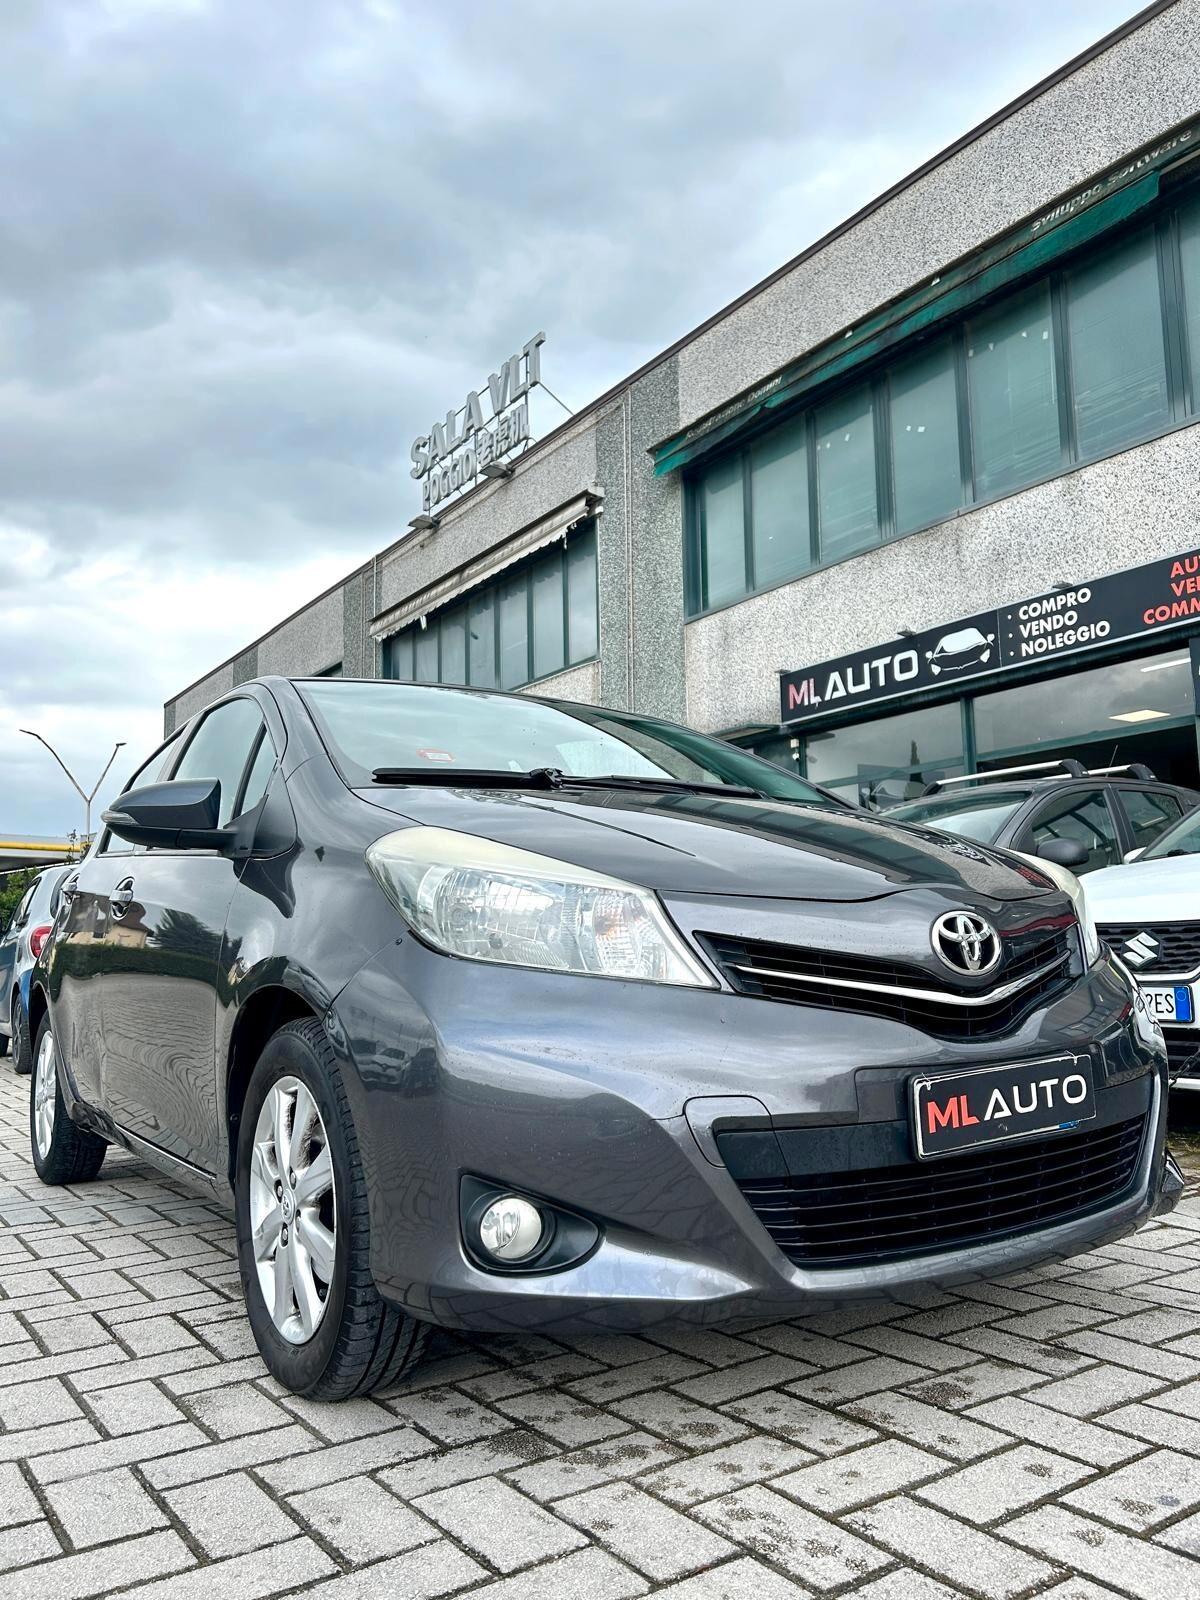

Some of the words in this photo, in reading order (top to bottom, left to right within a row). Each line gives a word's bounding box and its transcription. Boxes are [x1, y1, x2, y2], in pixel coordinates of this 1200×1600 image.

[1030, 183, 1101, 232] Sviluppo
[409, 390, 484, 480] SALA
[487, 331, 547, 416] VLT
[422, 448, 477, 512] POGGIO
[1170, 555, 1200, 579] AU
[1018, 586, 1092, 621] COMPRO
[1019, 610, 1078, 639] VENDO
[1020, 620, 1111, 657] NOLEGGIO
[824, 649, 920, 702] AUTO
[927, 1094, 980, 1134] ML
[983, 1074, 1088, 1121] AUTO
